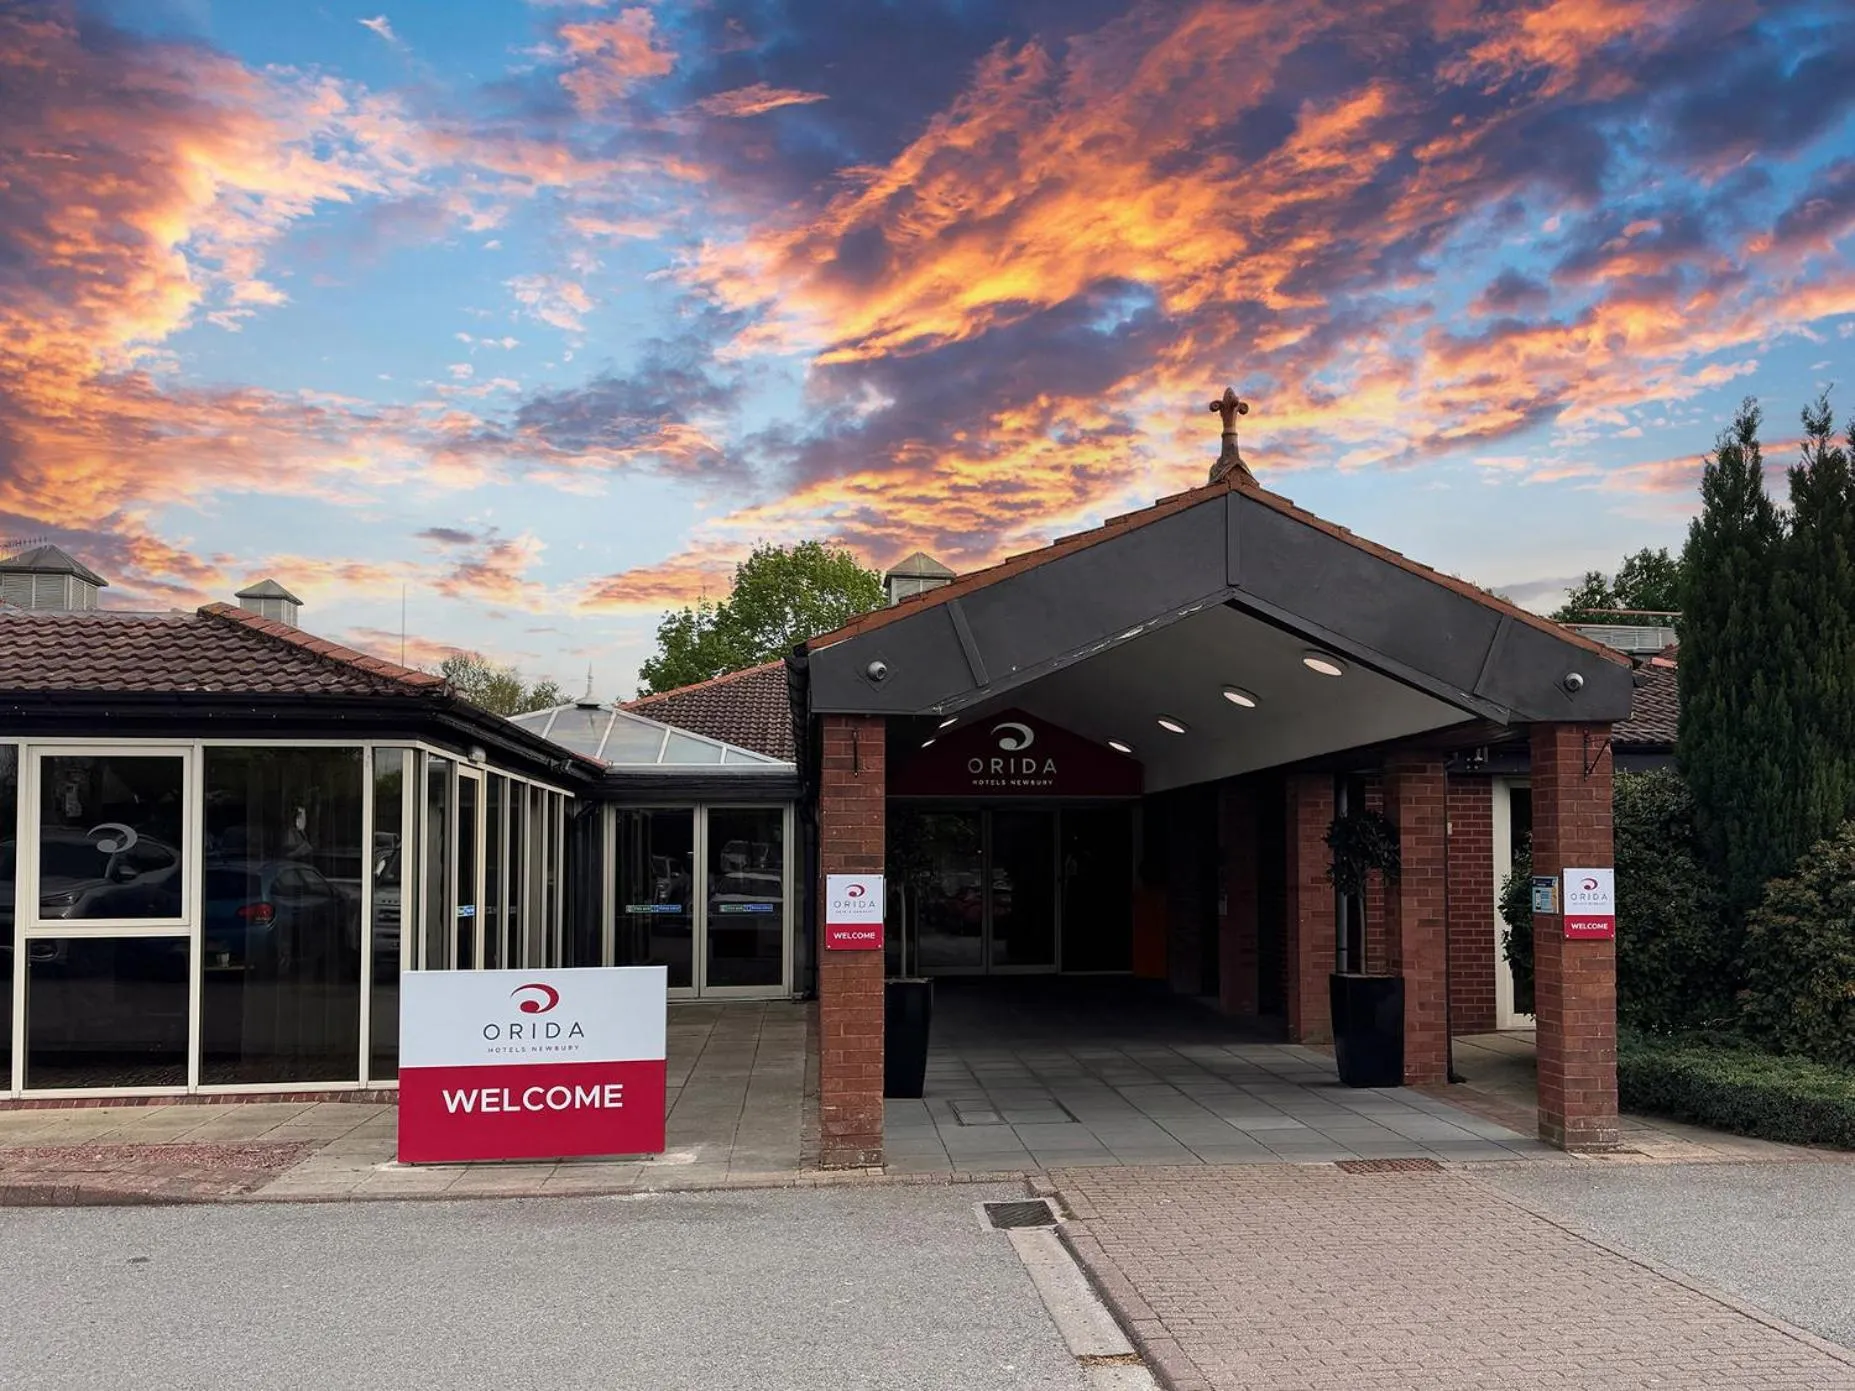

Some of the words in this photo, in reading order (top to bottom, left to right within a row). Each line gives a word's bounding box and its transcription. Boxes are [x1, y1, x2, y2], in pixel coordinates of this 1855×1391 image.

[967, 757, 1057, 774] ORIDA
[1570, 892, 1608, 901] ORIDA
[833, 900, 876, 909] ORIDA
[1571, 922, 1609, 930] WELCOME
[833, 931, 876, 940] WELCOME
[483, 1021, 585, 1041] ORIDA
[442, 1083, 623, 1114] WELCOME
